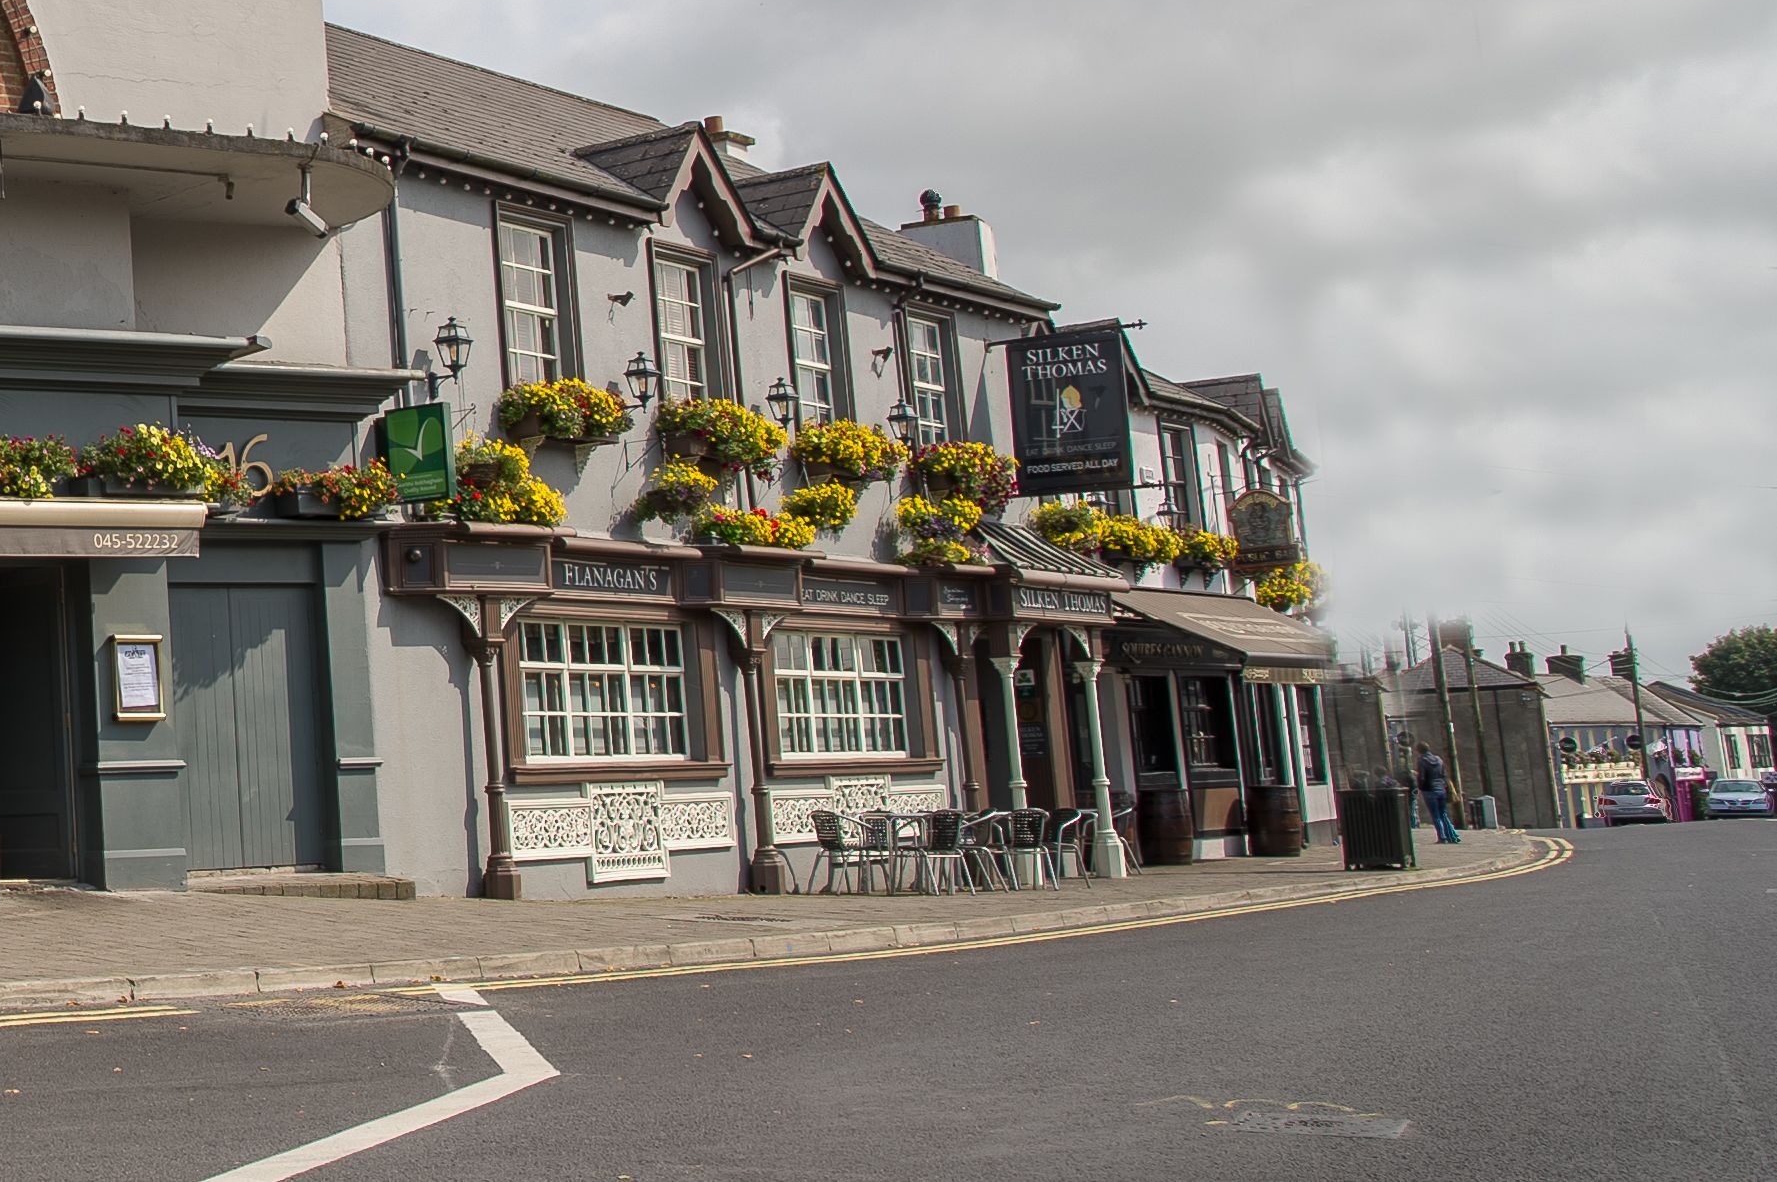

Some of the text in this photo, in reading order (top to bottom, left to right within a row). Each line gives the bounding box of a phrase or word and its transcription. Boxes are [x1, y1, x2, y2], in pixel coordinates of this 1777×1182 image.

[1026, 343, 1099, 365] SILKEN
[1022, 359, 1107, 381] THOMAS
[218, 433, 274, 497] 16
[1027, 458, 1119, 474] FOOD SERVED ALL DAY
[93, 533, 179, 549] 045-522232
[563, 563, 657, 591] FLANAGAN'S
[801, 588, 889, 606] EAT DRINK DANCE SLEEP
[1020, 587, 1106, 614] SILKEN THOMAS
